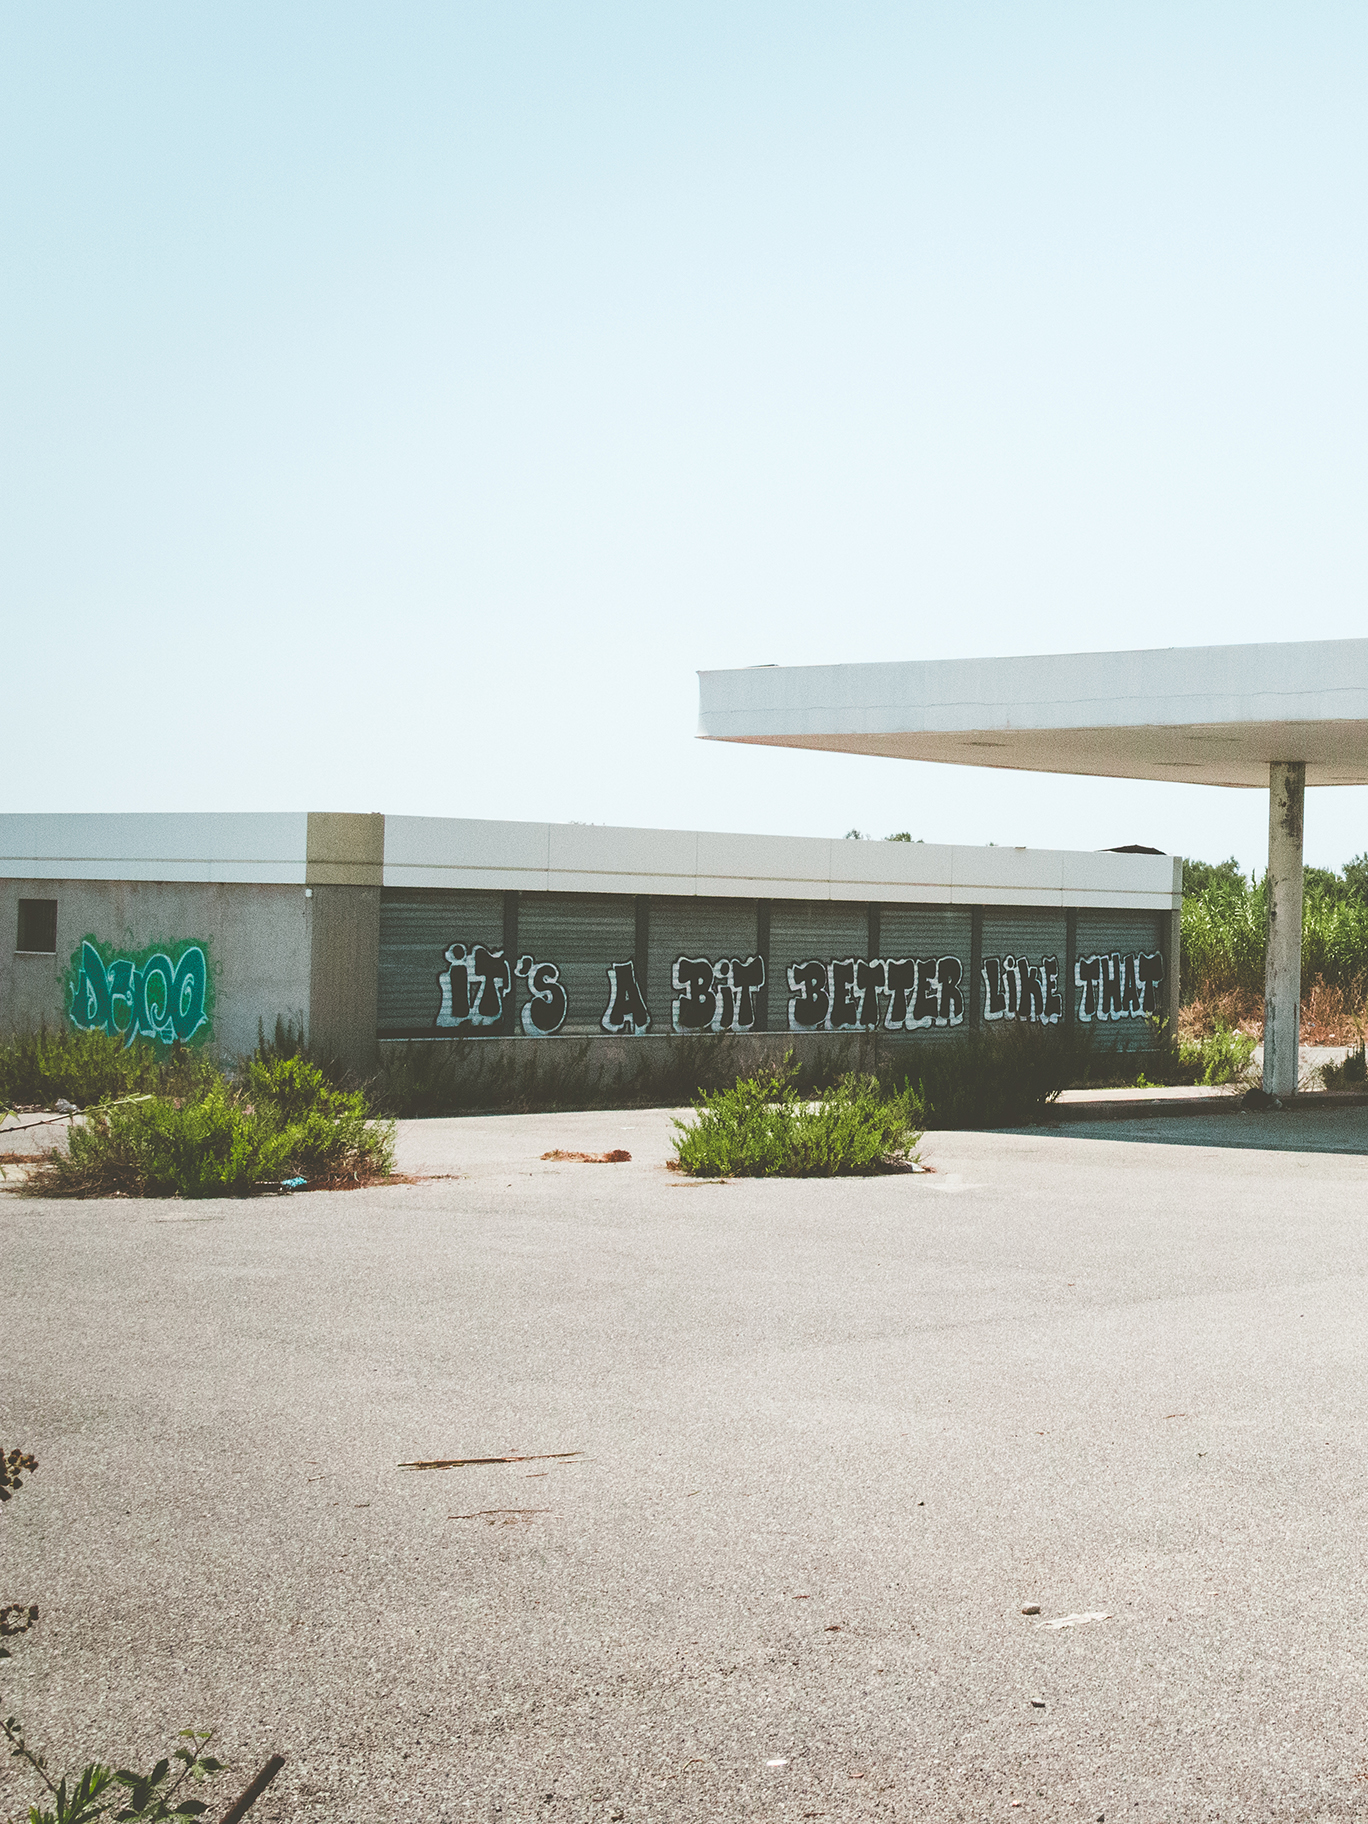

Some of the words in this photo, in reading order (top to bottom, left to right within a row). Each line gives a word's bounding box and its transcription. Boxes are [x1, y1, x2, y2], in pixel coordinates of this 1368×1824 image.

[601, 960, 651, 1035] A
[786, 955, 965, 1031] BETTER
[1074, 951, 1164, 1022] THAT
